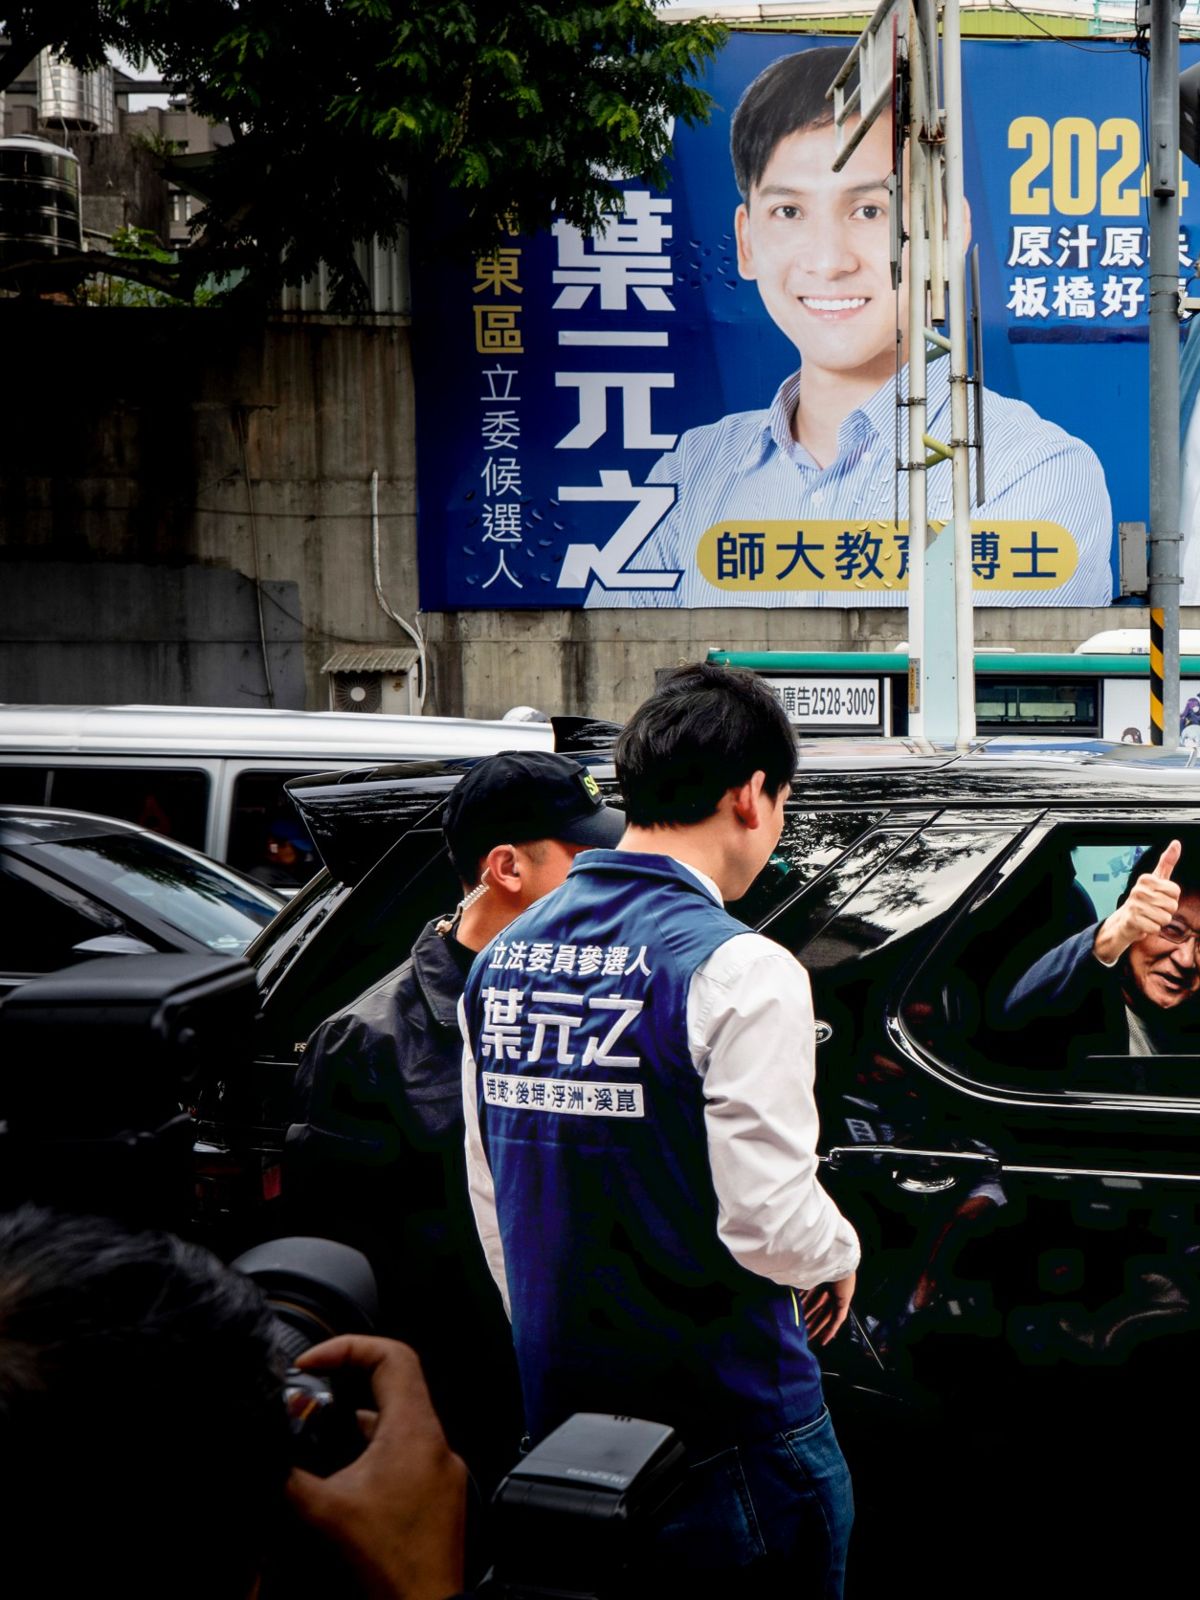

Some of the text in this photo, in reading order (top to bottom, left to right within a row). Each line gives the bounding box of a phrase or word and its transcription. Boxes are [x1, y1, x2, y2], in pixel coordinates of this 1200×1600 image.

[1006, 275, 1193, 319] 板橋好
[551, 190, 685, 589] 葉元之
[481, 365, 523, 589] 立委候選人
[488, 941, 652, 977] 立法委員參選人
[481, 986, 645, 1068] 葉元之
